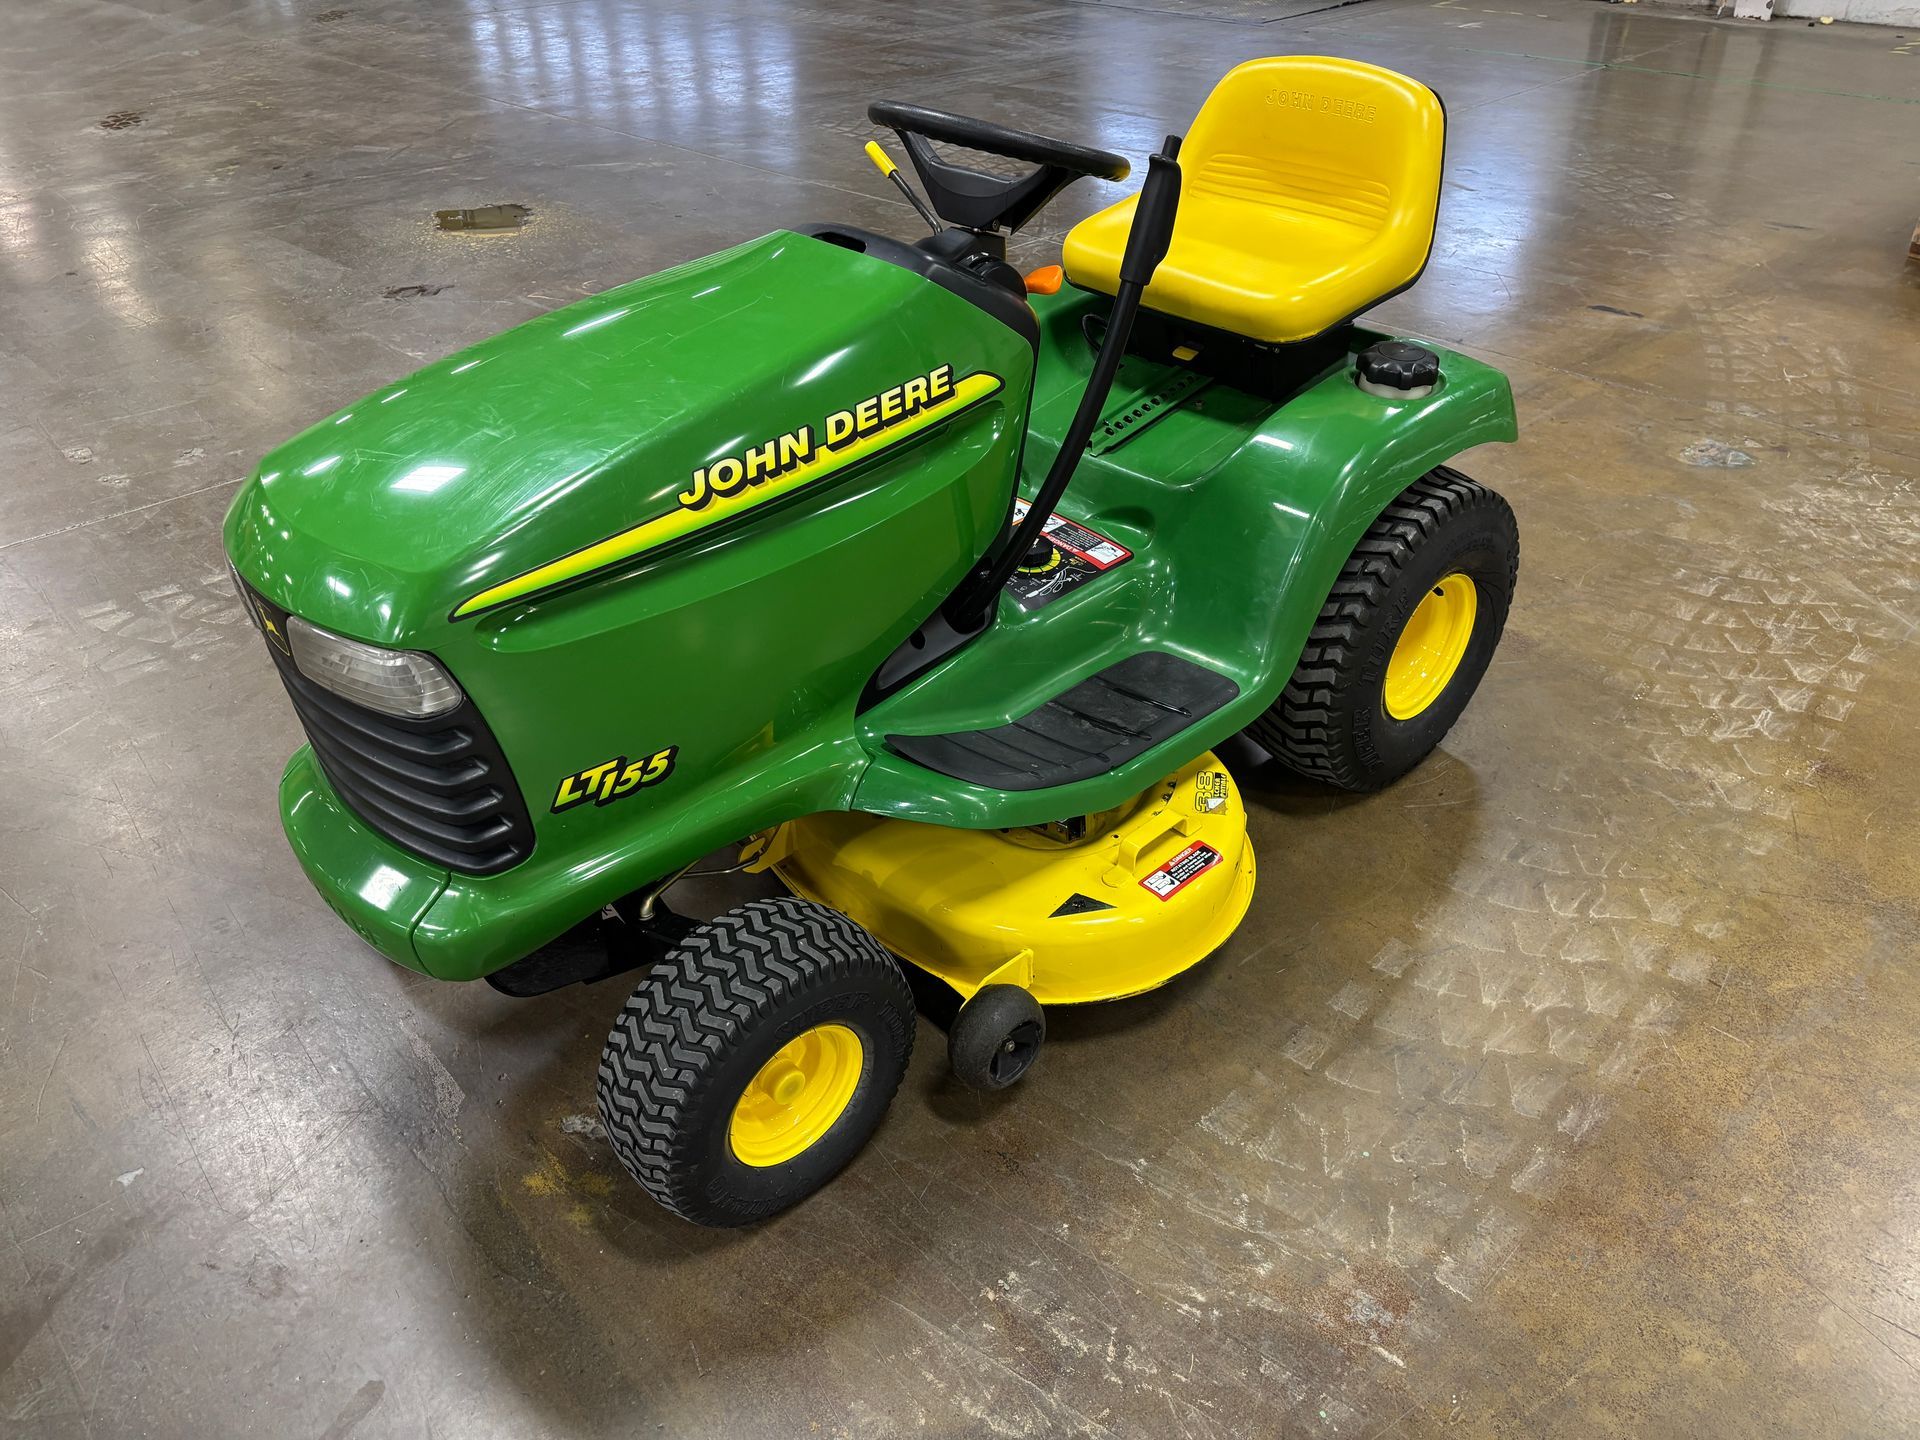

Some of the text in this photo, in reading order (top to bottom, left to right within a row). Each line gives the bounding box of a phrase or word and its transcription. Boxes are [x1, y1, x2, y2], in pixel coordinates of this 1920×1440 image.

[1265, 87, 1377, 124] JOHN DEERE
[678, 364, 954, 509] JOHN DEERE
[552, 746, 677, 812] LT155
[1195, 771, 1214, 813] 38
[1172, 847, 1194, 864] DANGER
